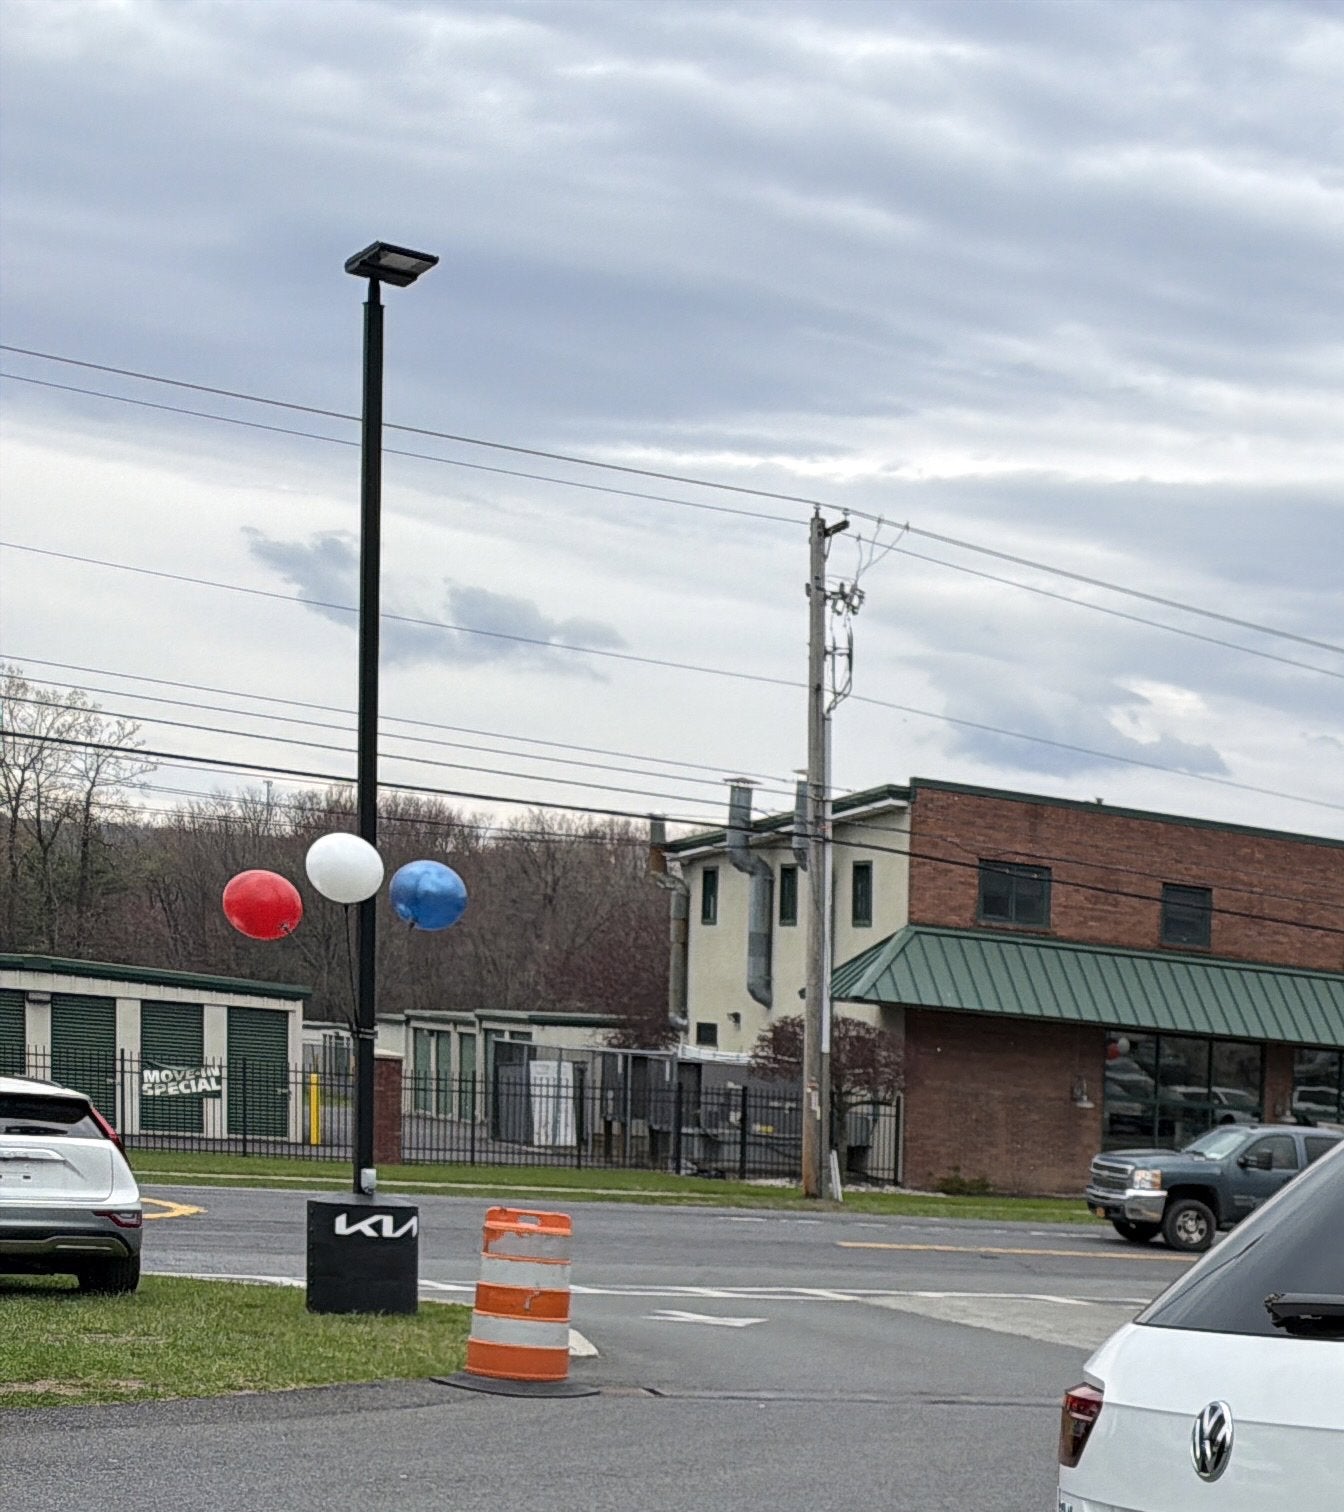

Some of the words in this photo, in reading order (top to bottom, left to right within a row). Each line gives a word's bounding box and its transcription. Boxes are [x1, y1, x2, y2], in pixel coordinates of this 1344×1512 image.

[142, 1065, 220, 1083] MOVE-IN
[142, 1077, 221, 1096] SPECIAL
[335, 1213, 418, 1238] KIA
